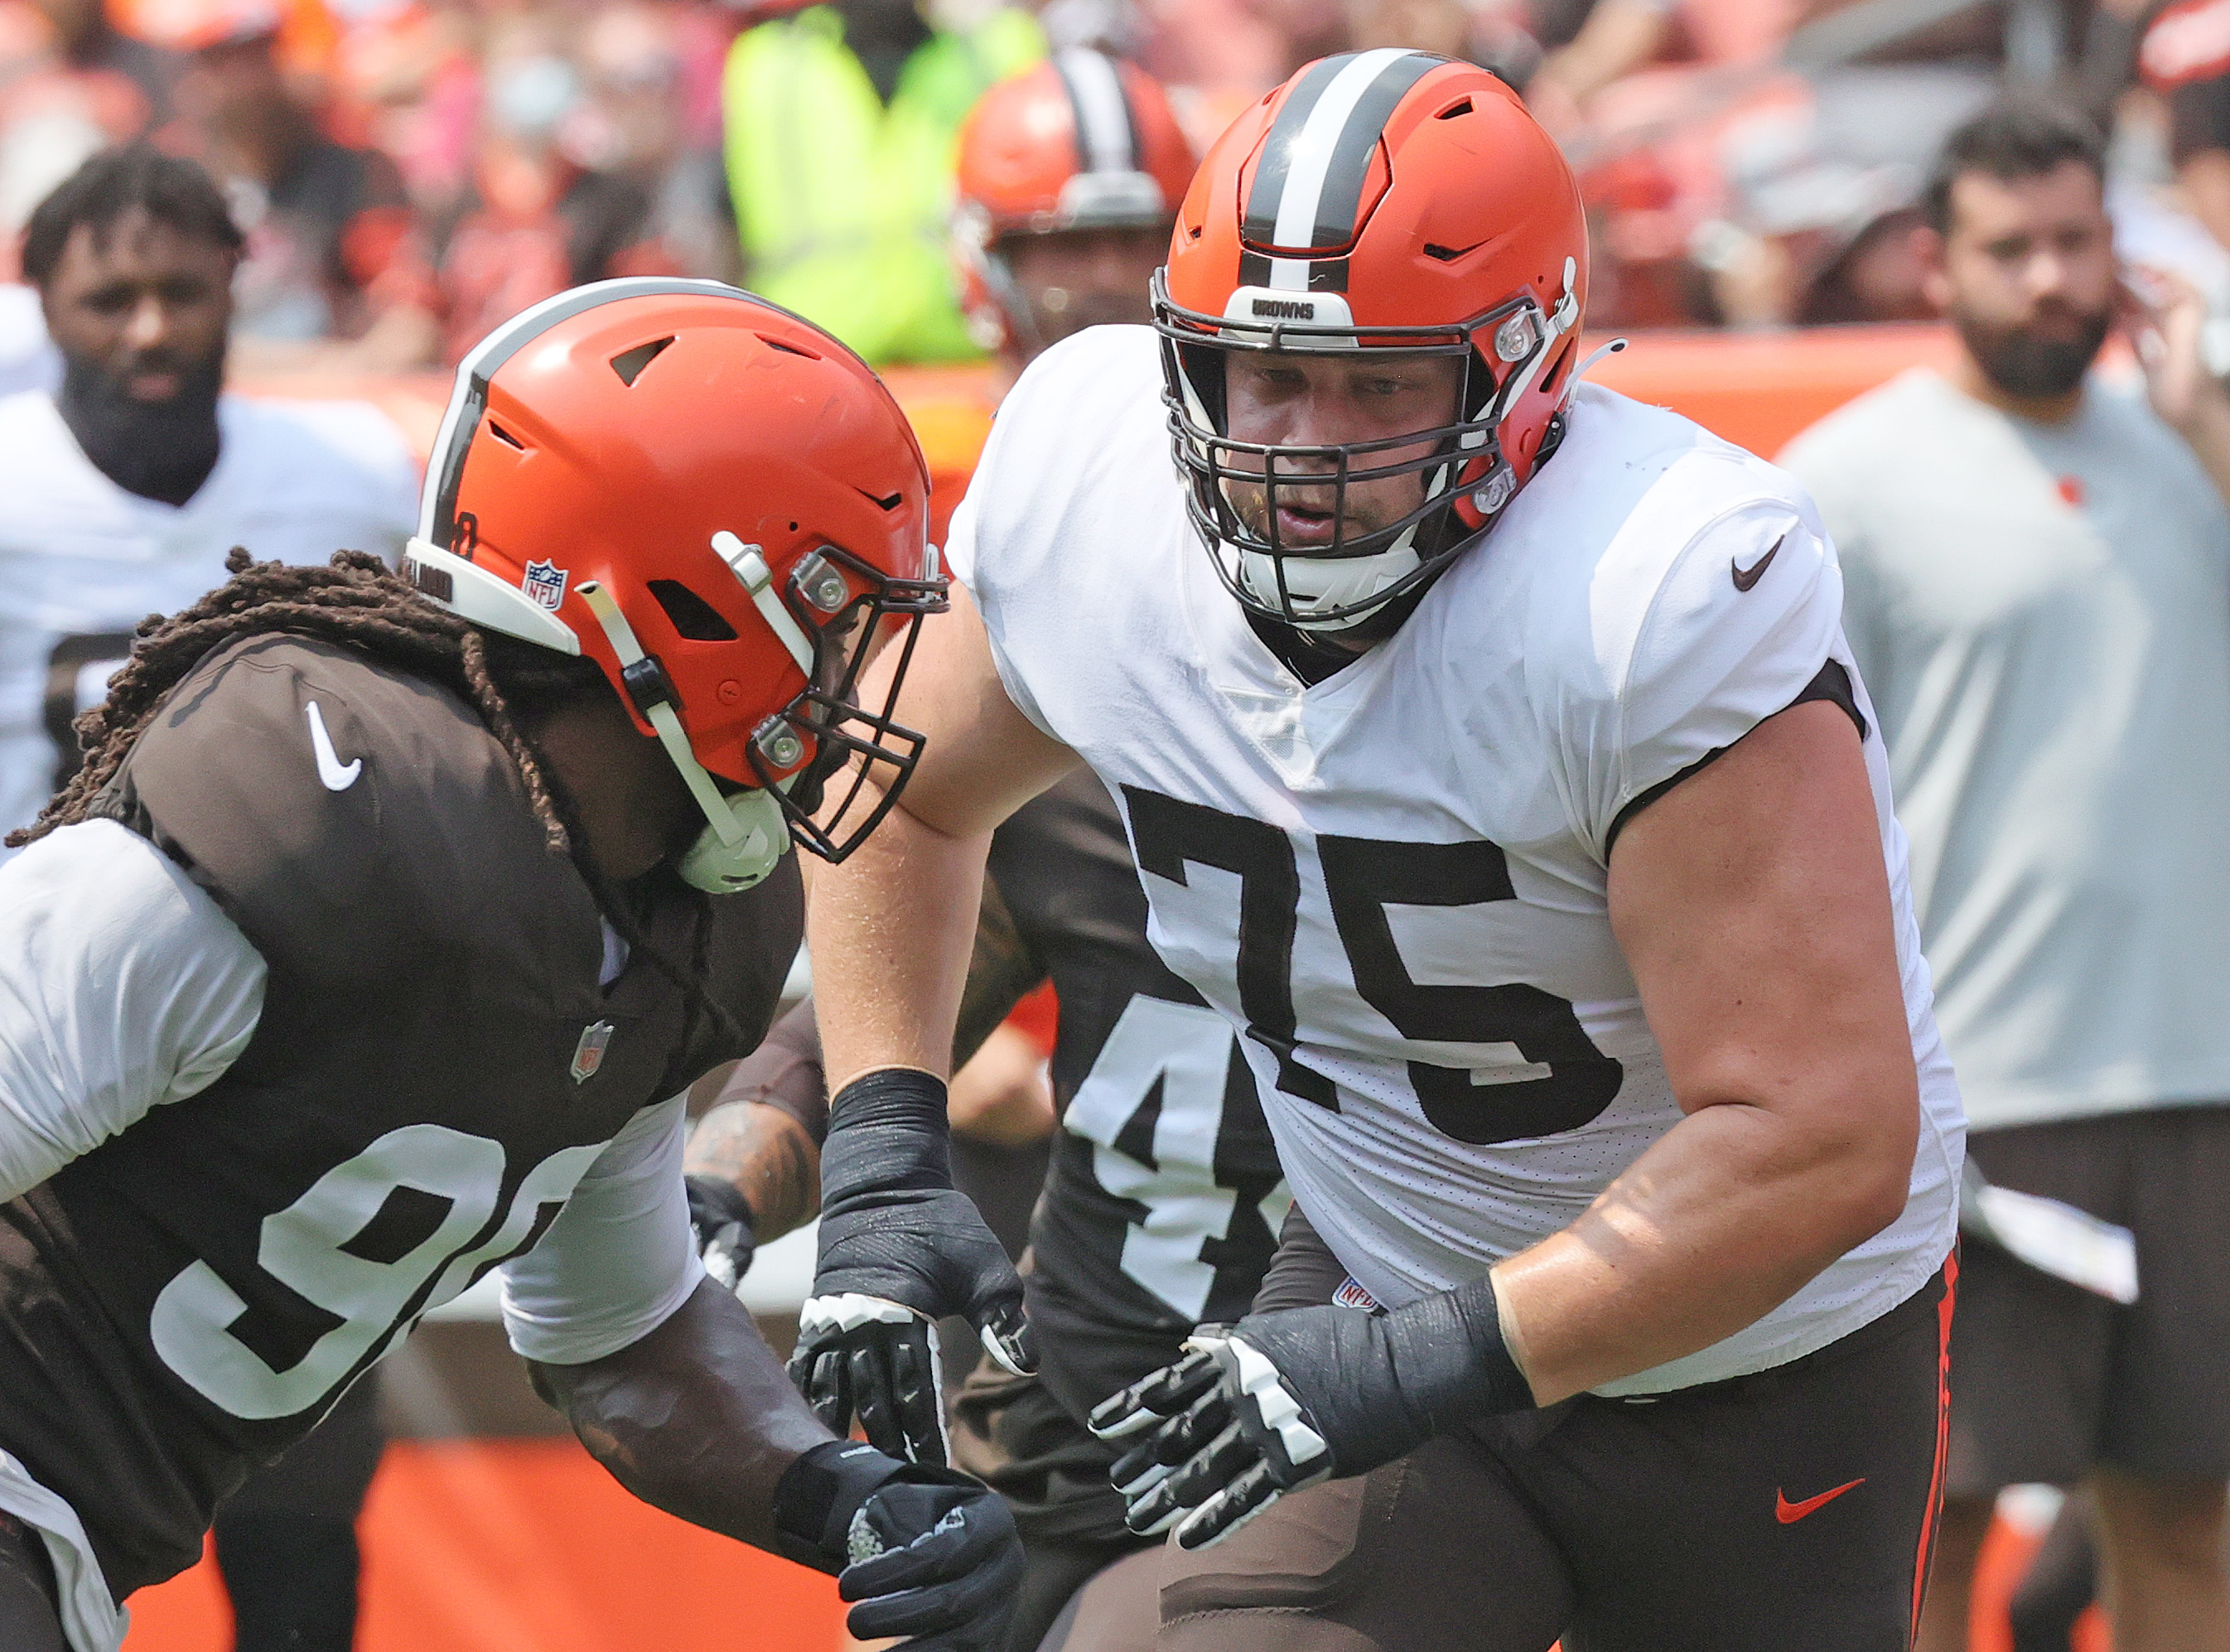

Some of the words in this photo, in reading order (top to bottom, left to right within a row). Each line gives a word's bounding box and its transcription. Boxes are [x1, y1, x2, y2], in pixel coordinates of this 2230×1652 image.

[1252, 298, 1315, 320] BROWNS
[528, 580, 558, 606] NFL
[1120, 782, 1624, 1145] 75
[1340, 1285, 1373, 1307] NFL
